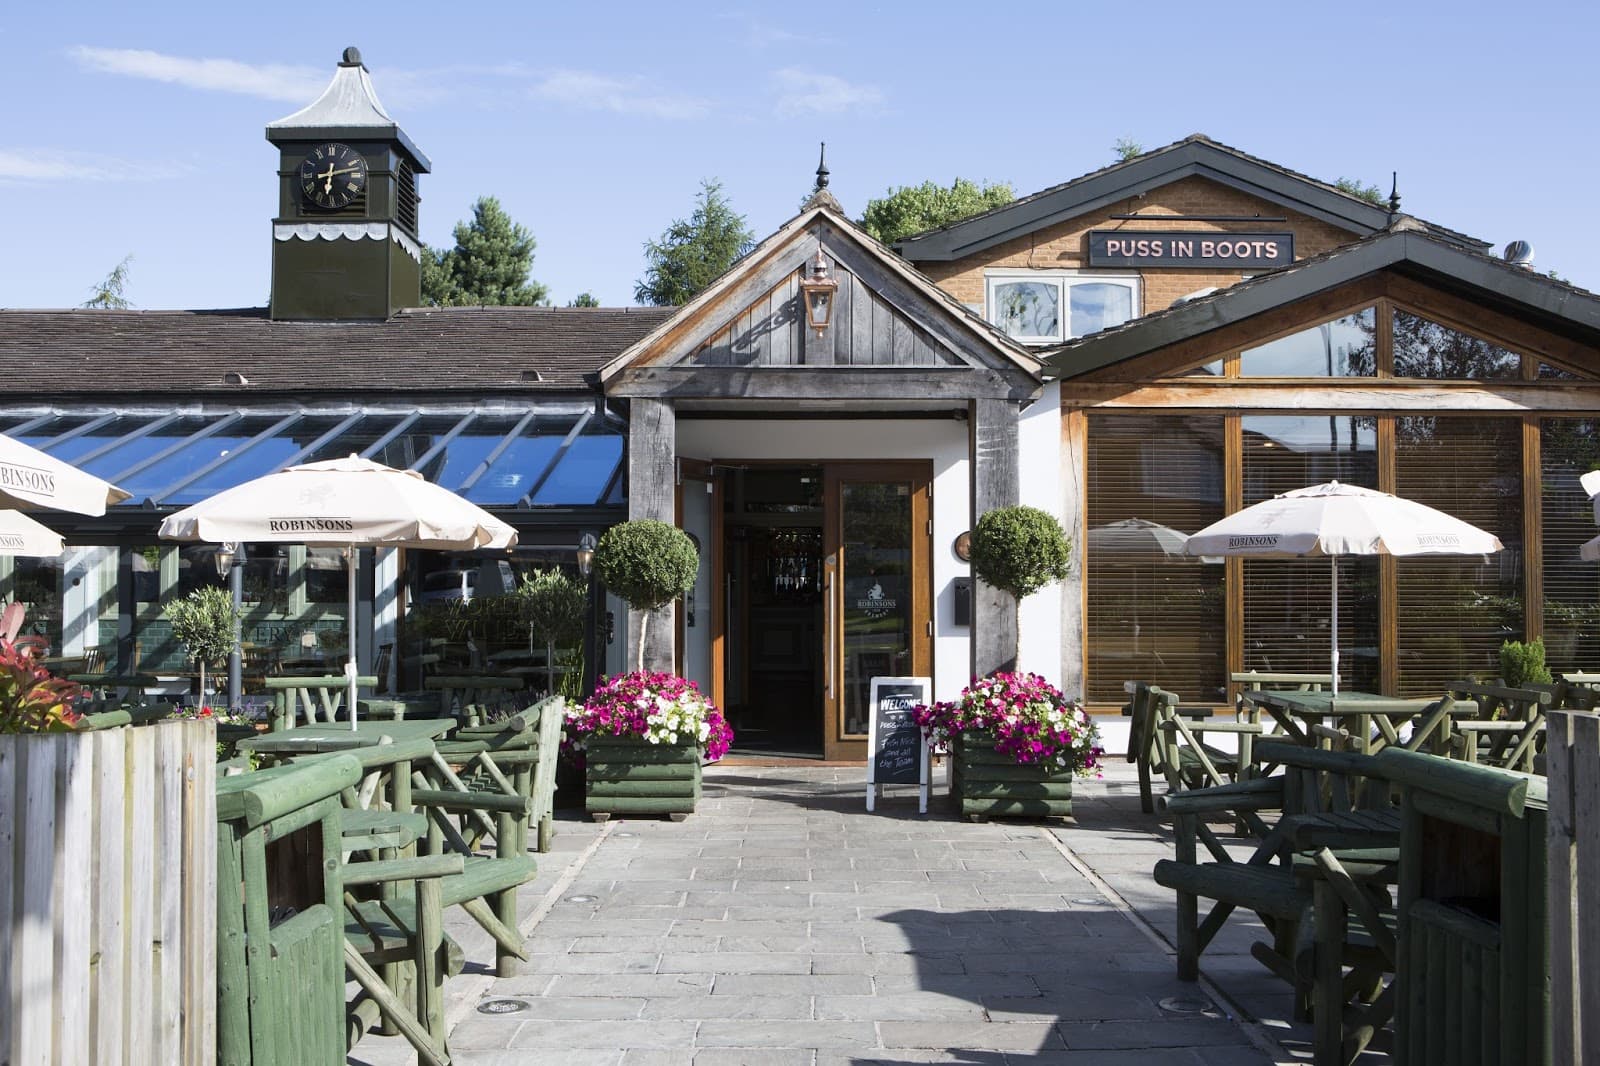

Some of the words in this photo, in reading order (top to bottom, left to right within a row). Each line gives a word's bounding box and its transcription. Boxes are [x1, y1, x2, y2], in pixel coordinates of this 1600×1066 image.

[1107, 239, 1163, 257] PUSS
[1171, 240, 1193, 257] IN
[1201, 241, 1278, 259] BOOTS
[0, 467, 55, 493] BINSONS
[270, 519, 352, 531] ROBINSONS
[1229, 535, 1278, 547] ROBINSONS
